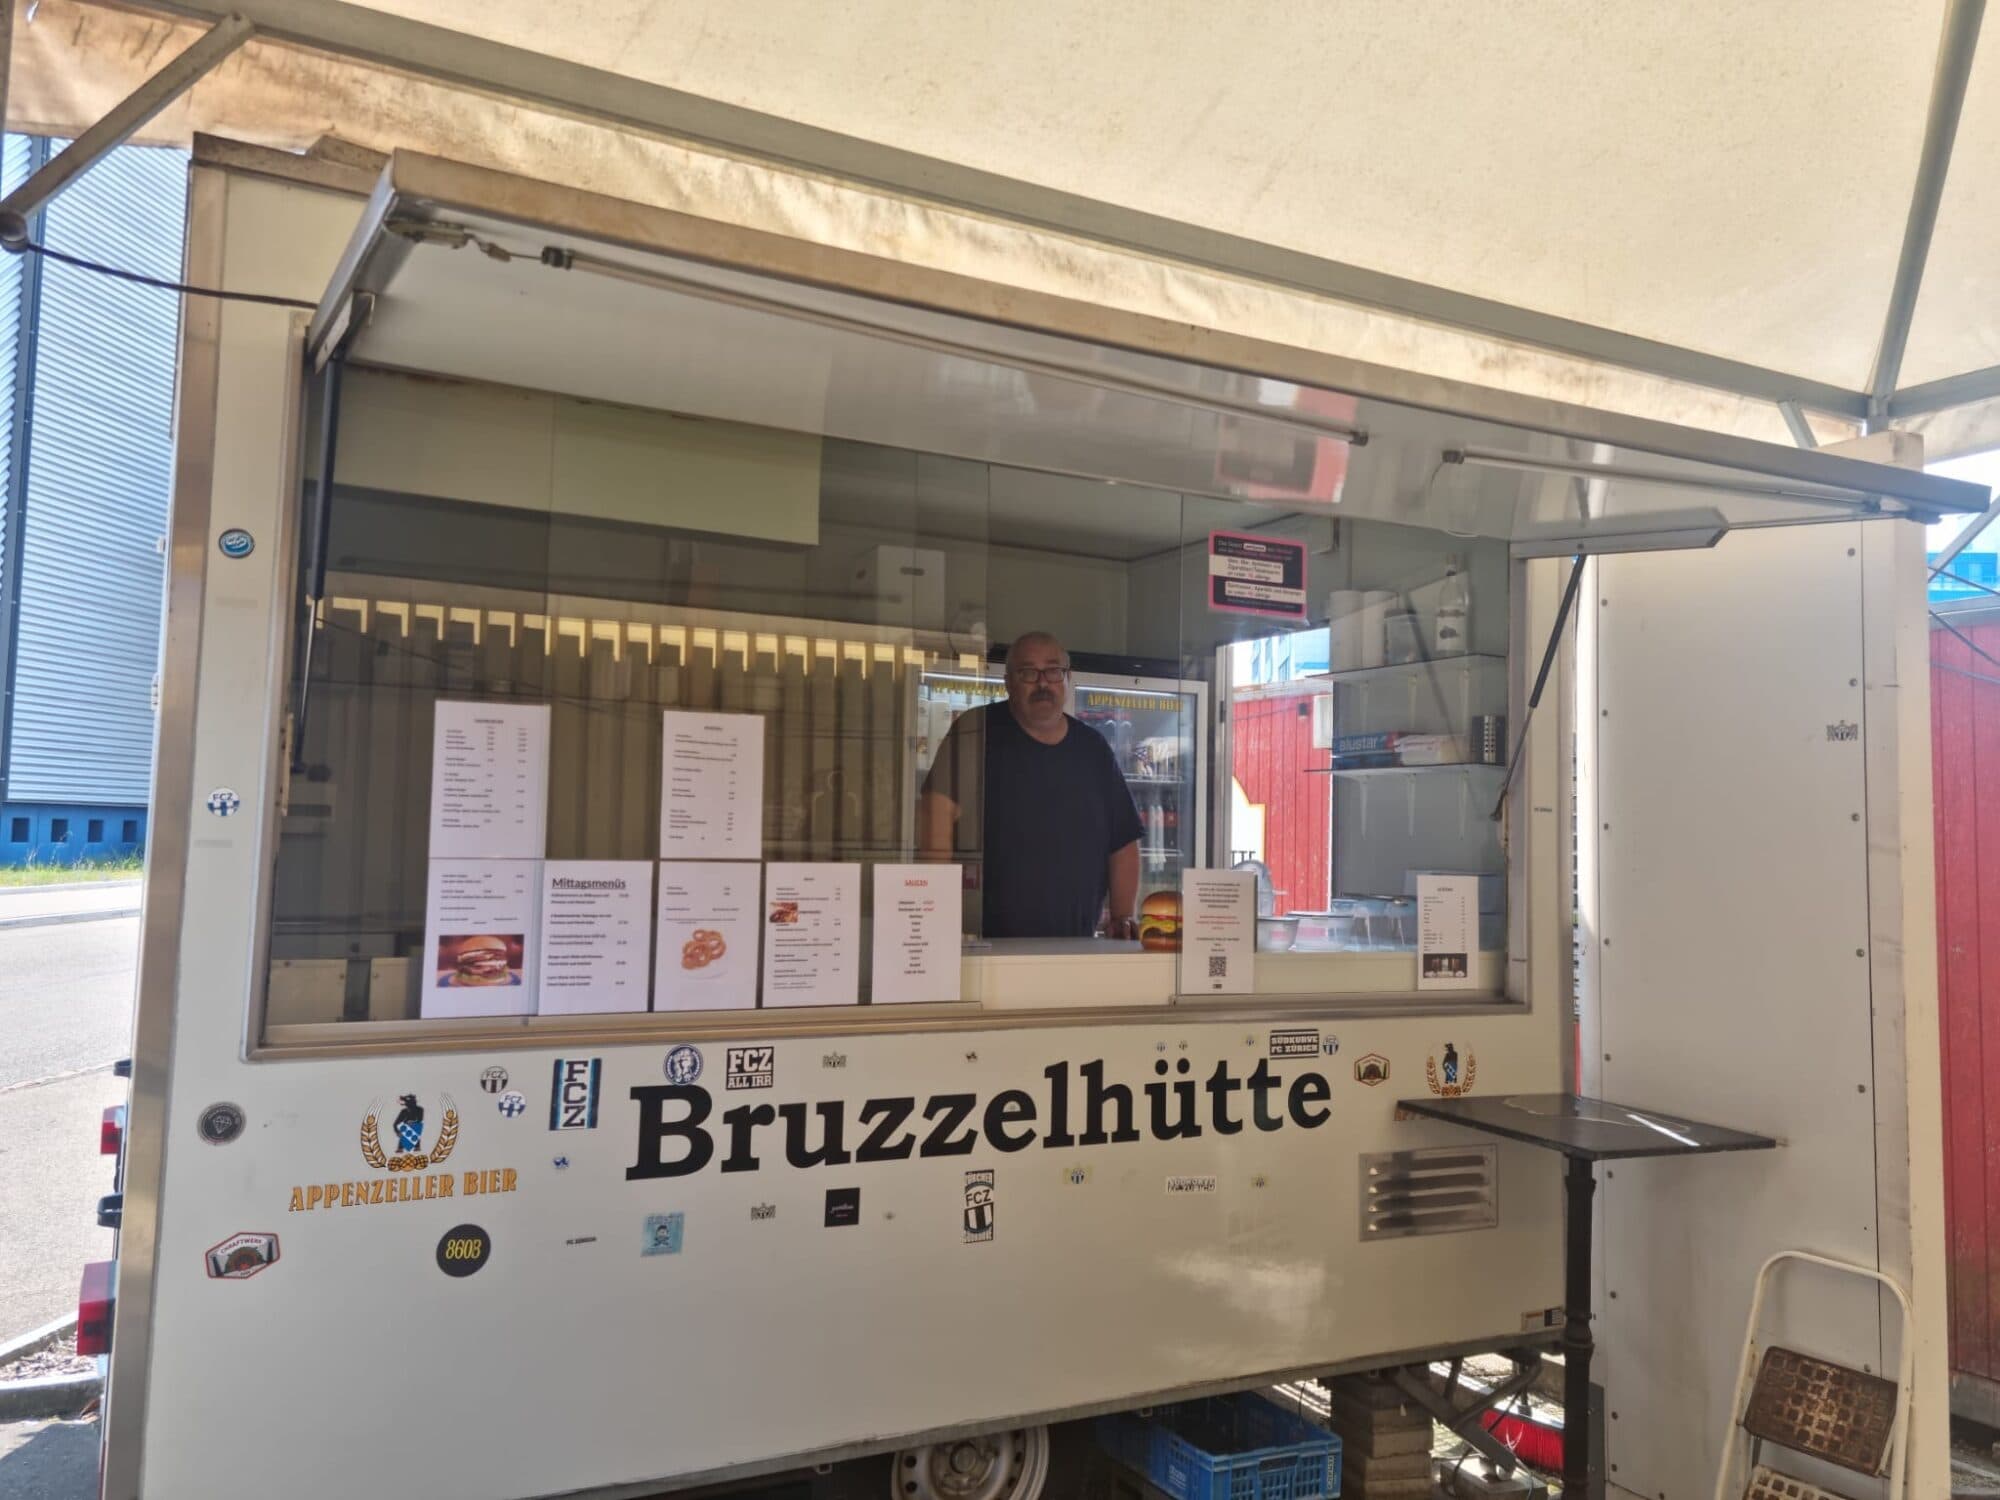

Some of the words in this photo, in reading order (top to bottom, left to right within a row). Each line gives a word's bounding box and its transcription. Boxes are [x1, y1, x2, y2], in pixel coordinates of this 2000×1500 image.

[551, 877, 627, 890] Mittagsmenüs
[728, 1048, 772, 1073] FCZ
[485, 1070, 504, 1079] FCZ
[728, 1077, 750, 1088] ALL
[503, 1094, 522, 1104] FCZ
[563, 1060, 589, 1127] FCZ
[626, 1056, 1331, 1181] Bruzzelhütte
[288, 1174, 455, 1212] APPENZELLER
[463, 1167, 518, 1196] BIER
[965, 1188, 991, 1207] FCZ
